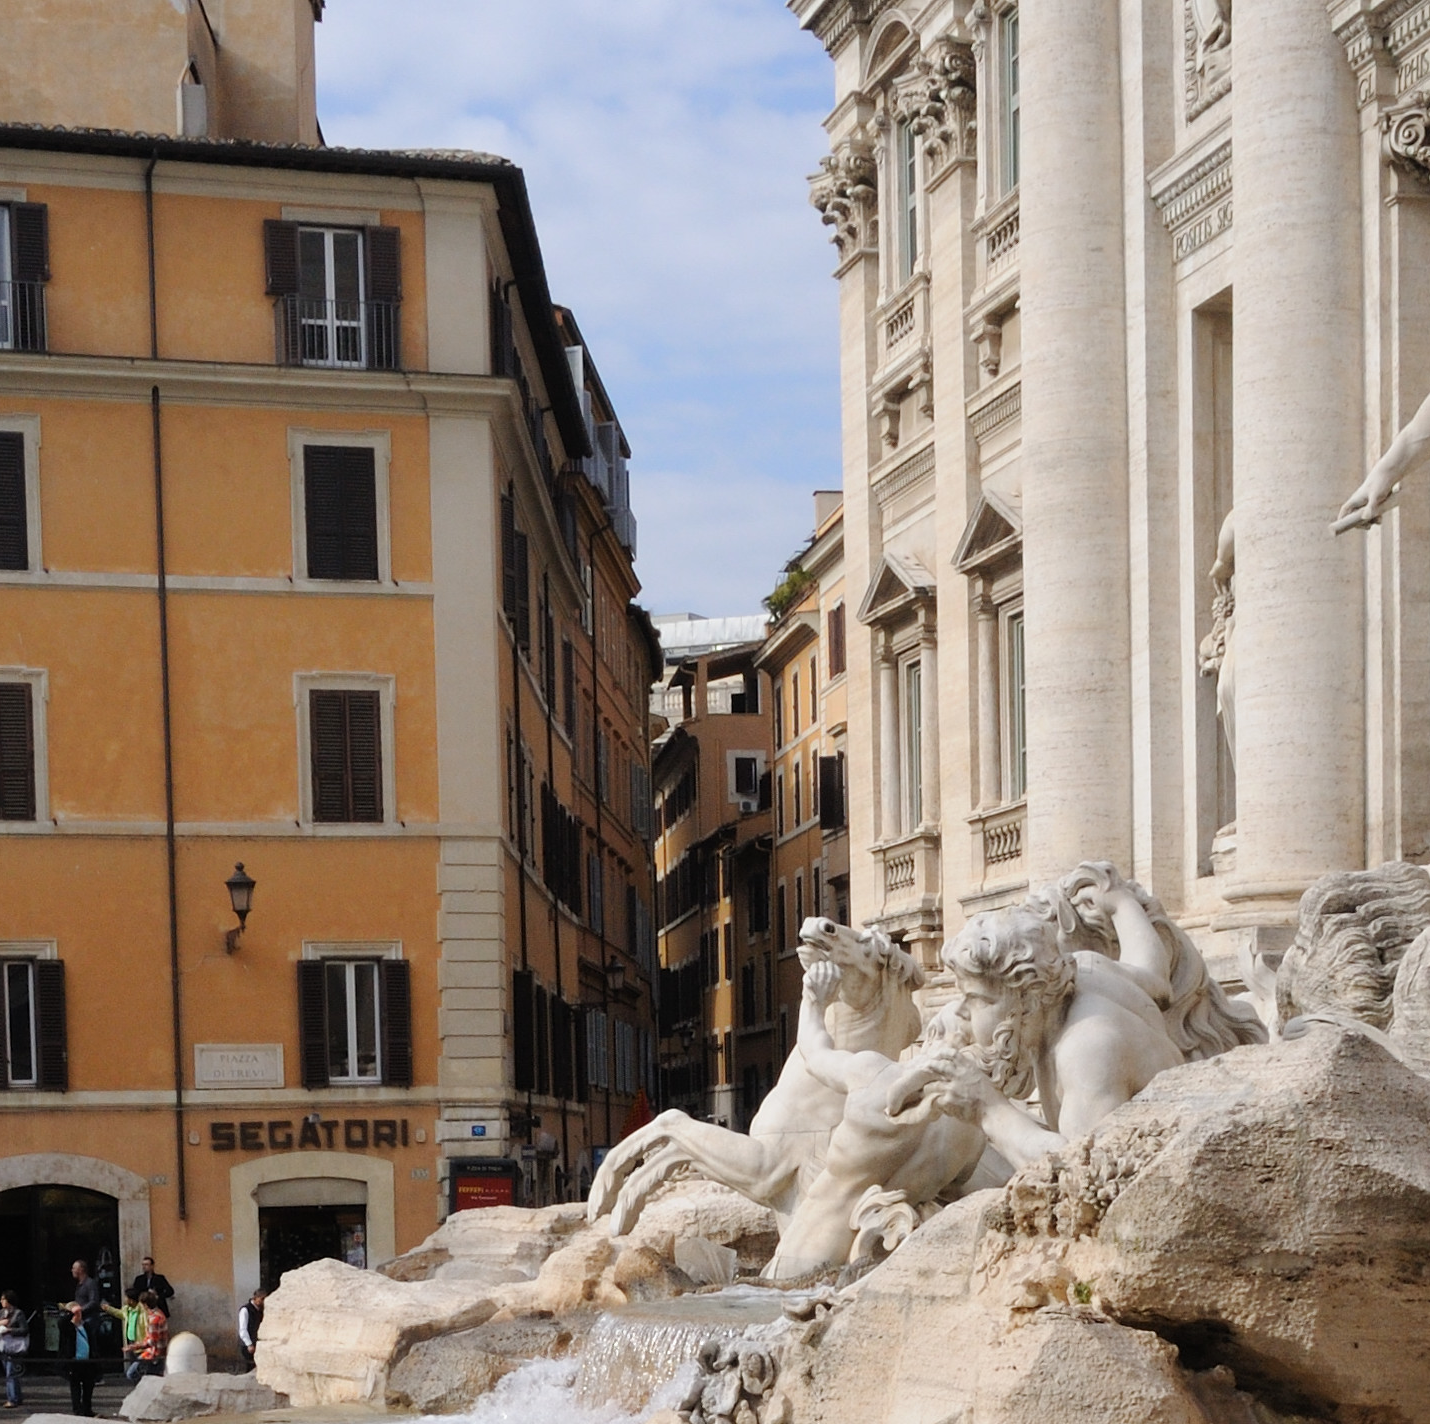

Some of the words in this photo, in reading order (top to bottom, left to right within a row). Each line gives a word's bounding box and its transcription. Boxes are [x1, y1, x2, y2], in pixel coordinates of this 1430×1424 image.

[1176, 214, 1212, 259] POSITIS
[220, 1054, 259, 1063] PIAZZA
[213, 1069, 225, 1078] DI
[230, 1069, 265, 1078] TREVI
[210, 1117, 409, 1151] SEGATORI
